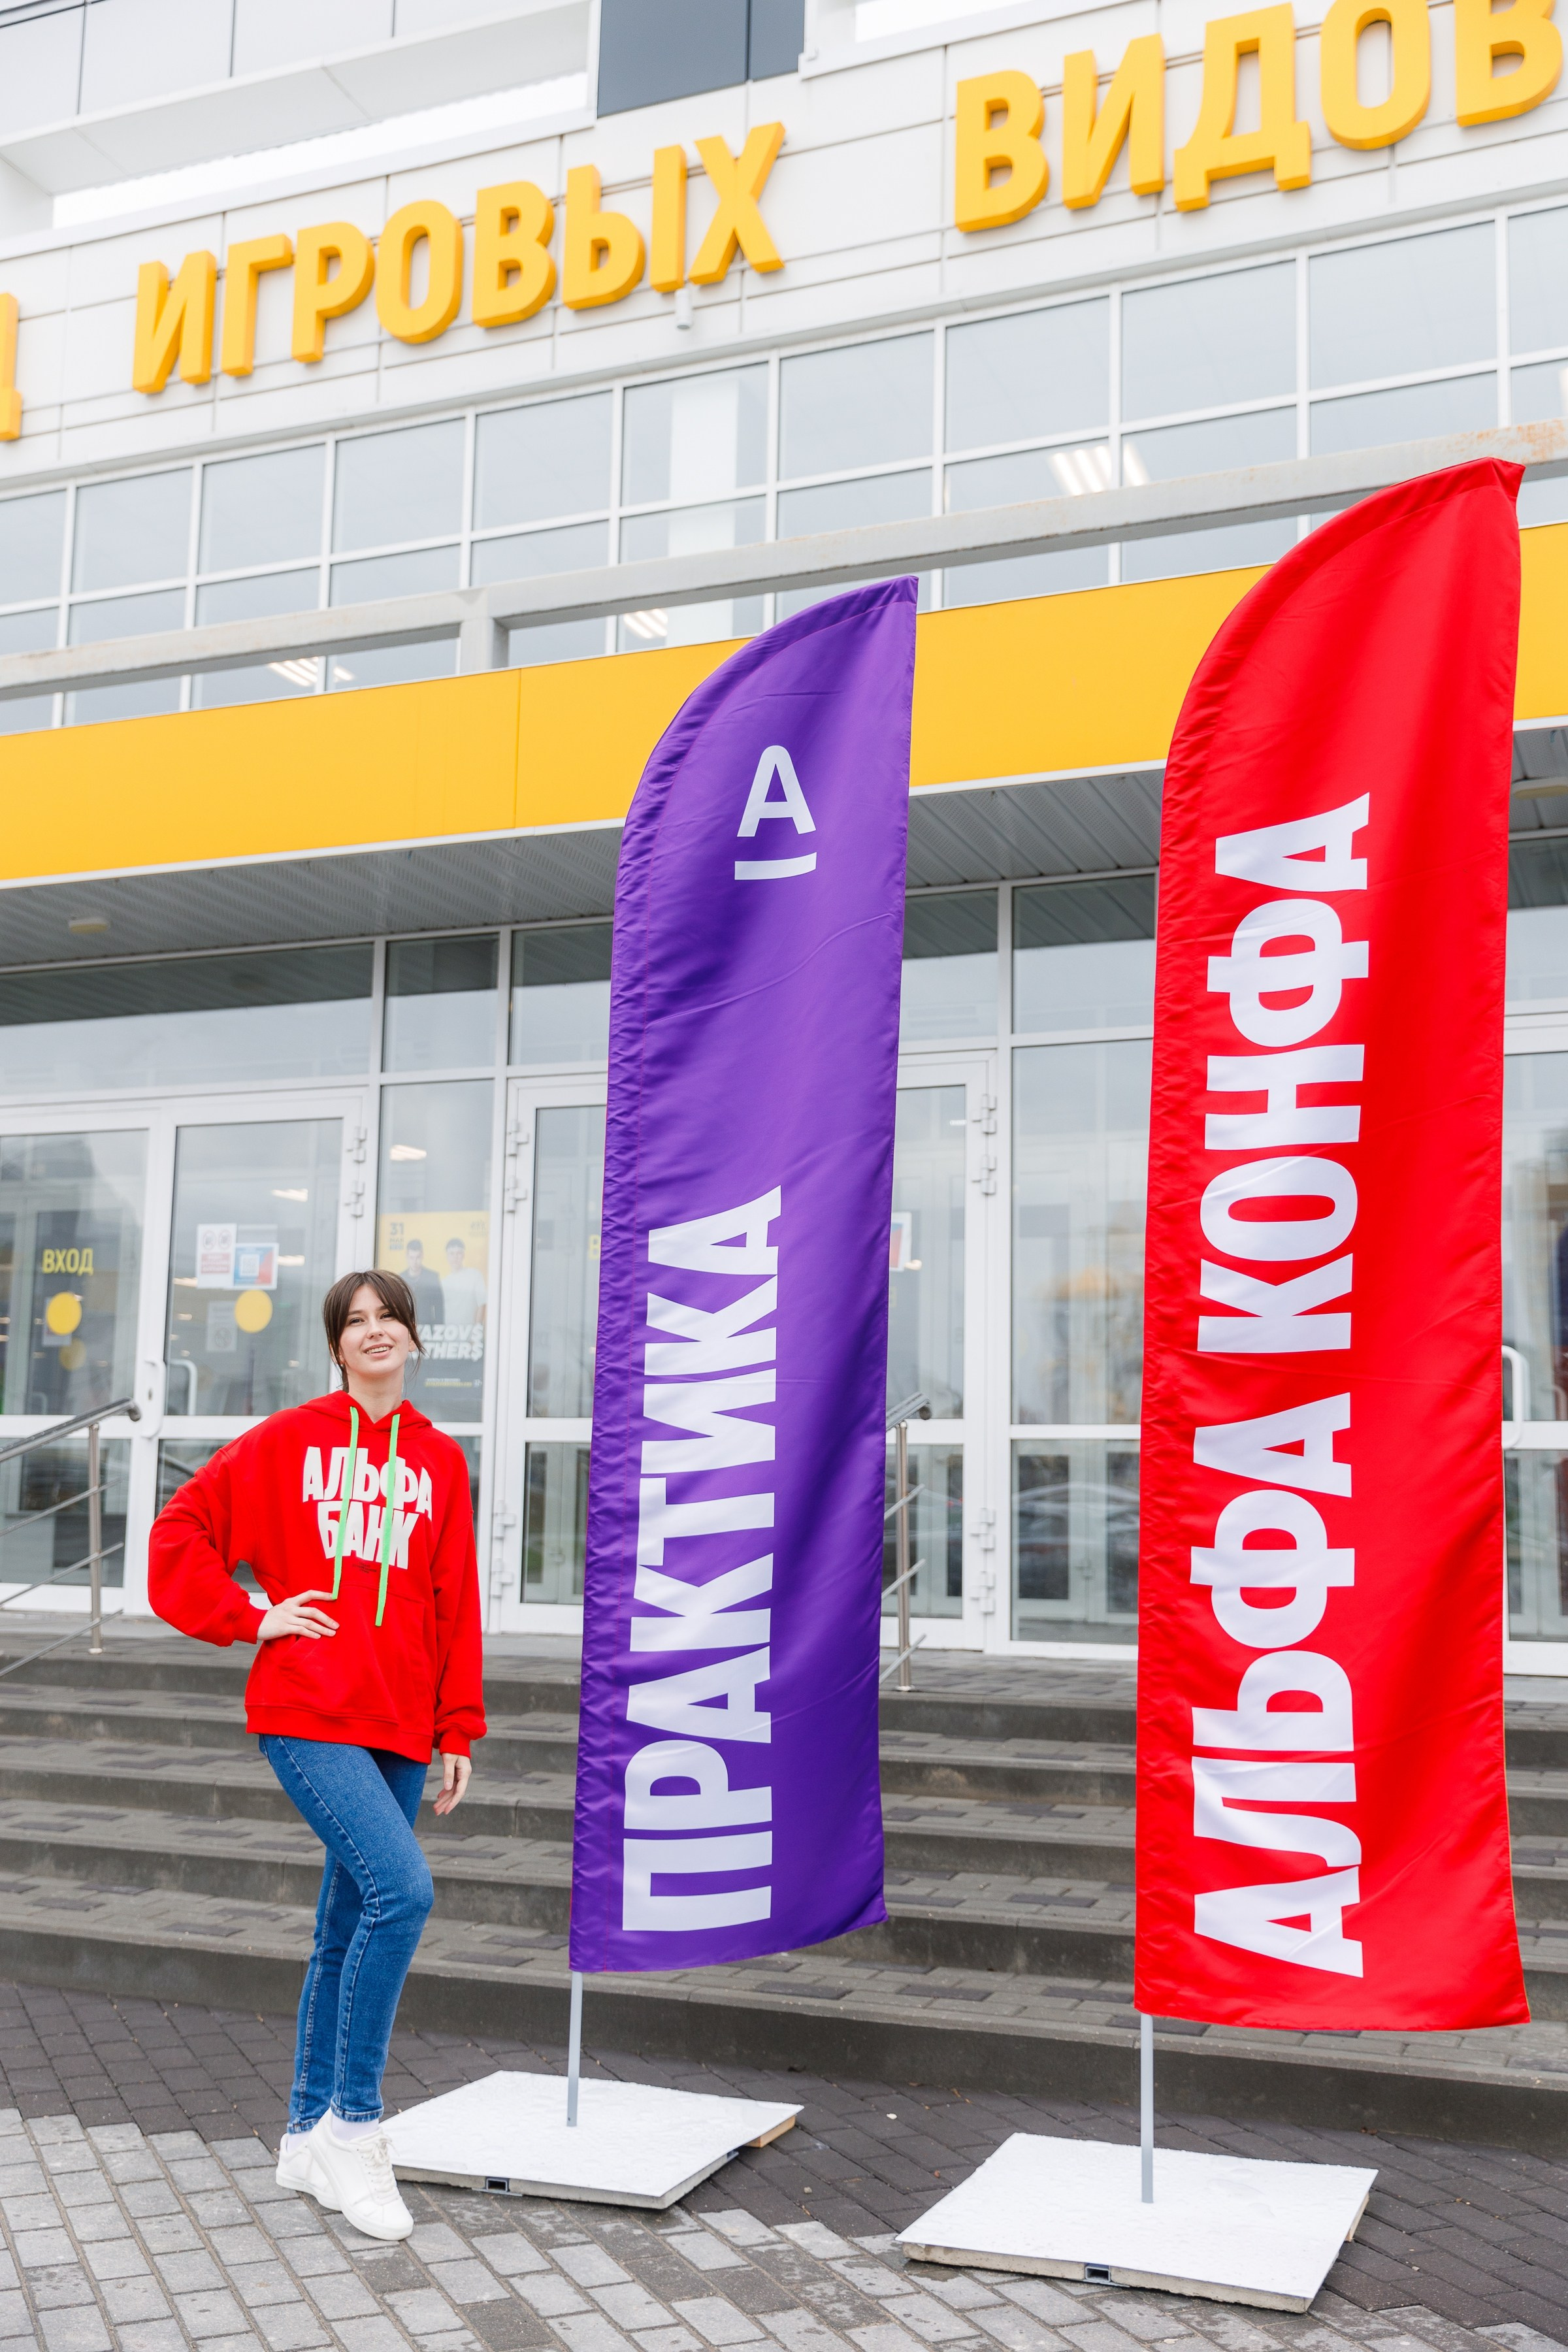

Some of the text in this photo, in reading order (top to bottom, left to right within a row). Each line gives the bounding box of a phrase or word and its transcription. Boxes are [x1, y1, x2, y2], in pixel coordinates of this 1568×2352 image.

[133, 122, 786, 395] ИГРОВЫХ
[955, 0, 1565, 233] ВИДОВ
[42, 1247, 94, 1277] ВХОД
[302, 1446, 433, 1522] АЛЬФА
[1190, 792, 1370, 1978] АЛЬФА КОНФА
[318, 1500, 419, 1570] БАНК
[622, 1184, 782, 1932] ПРАКТИКА
